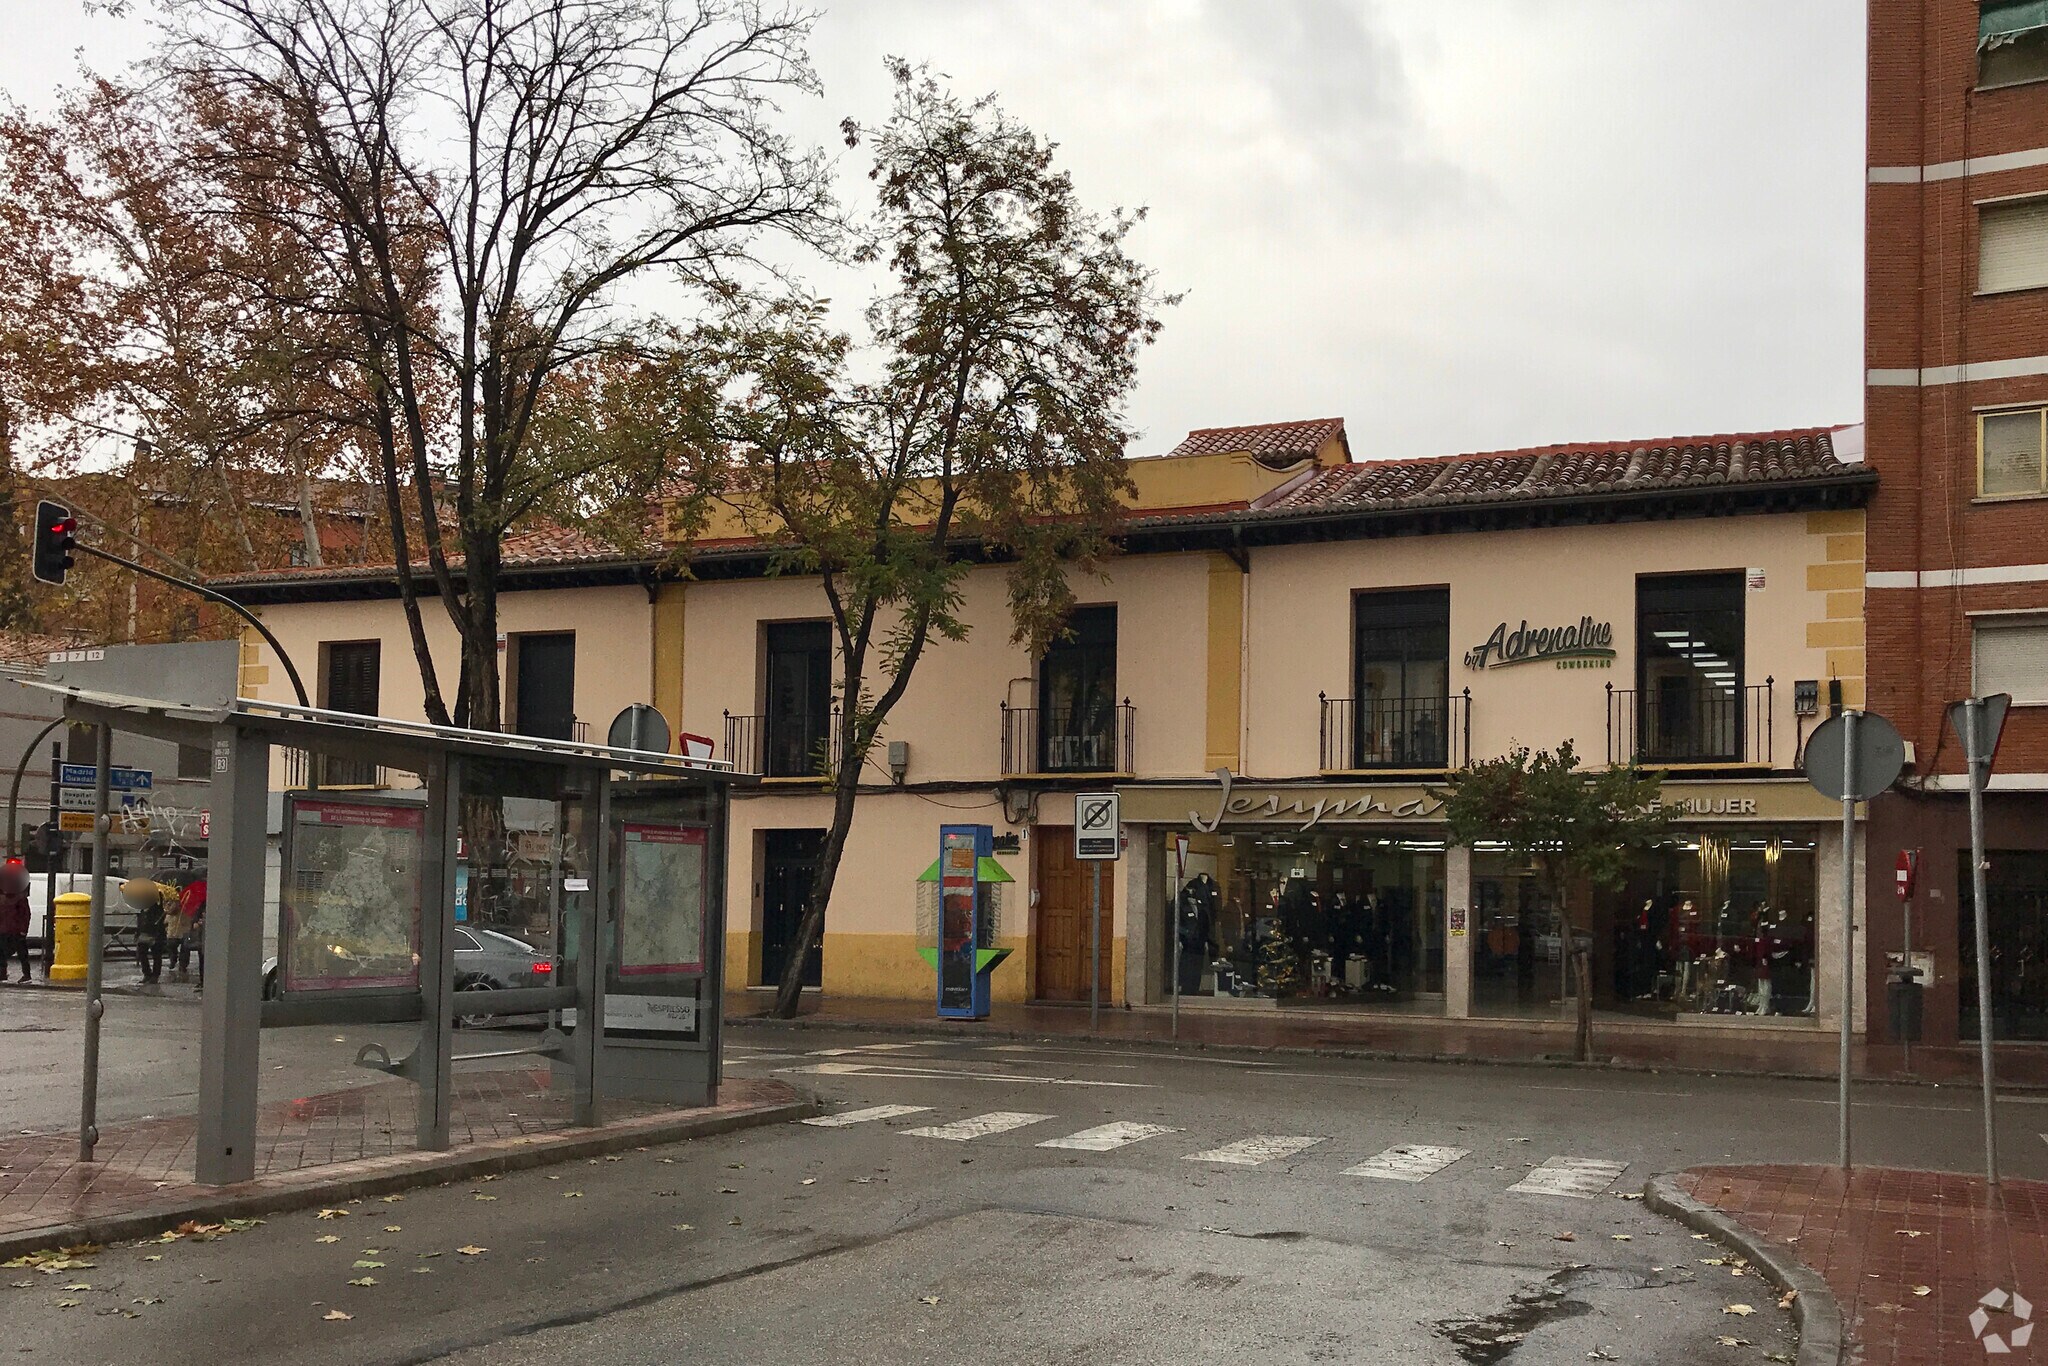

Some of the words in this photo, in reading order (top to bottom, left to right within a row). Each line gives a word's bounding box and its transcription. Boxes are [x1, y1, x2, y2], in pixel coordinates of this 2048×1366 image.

[1464, 651, 1480, 671] by
[1473, 615, 1613, 668] Adrenaline
[56, 653, 62, 661] 2
[75, 652, 81, 660] 7
[92, 651, 100, 659] 12
[65, 767, 94, 776] Madrid
